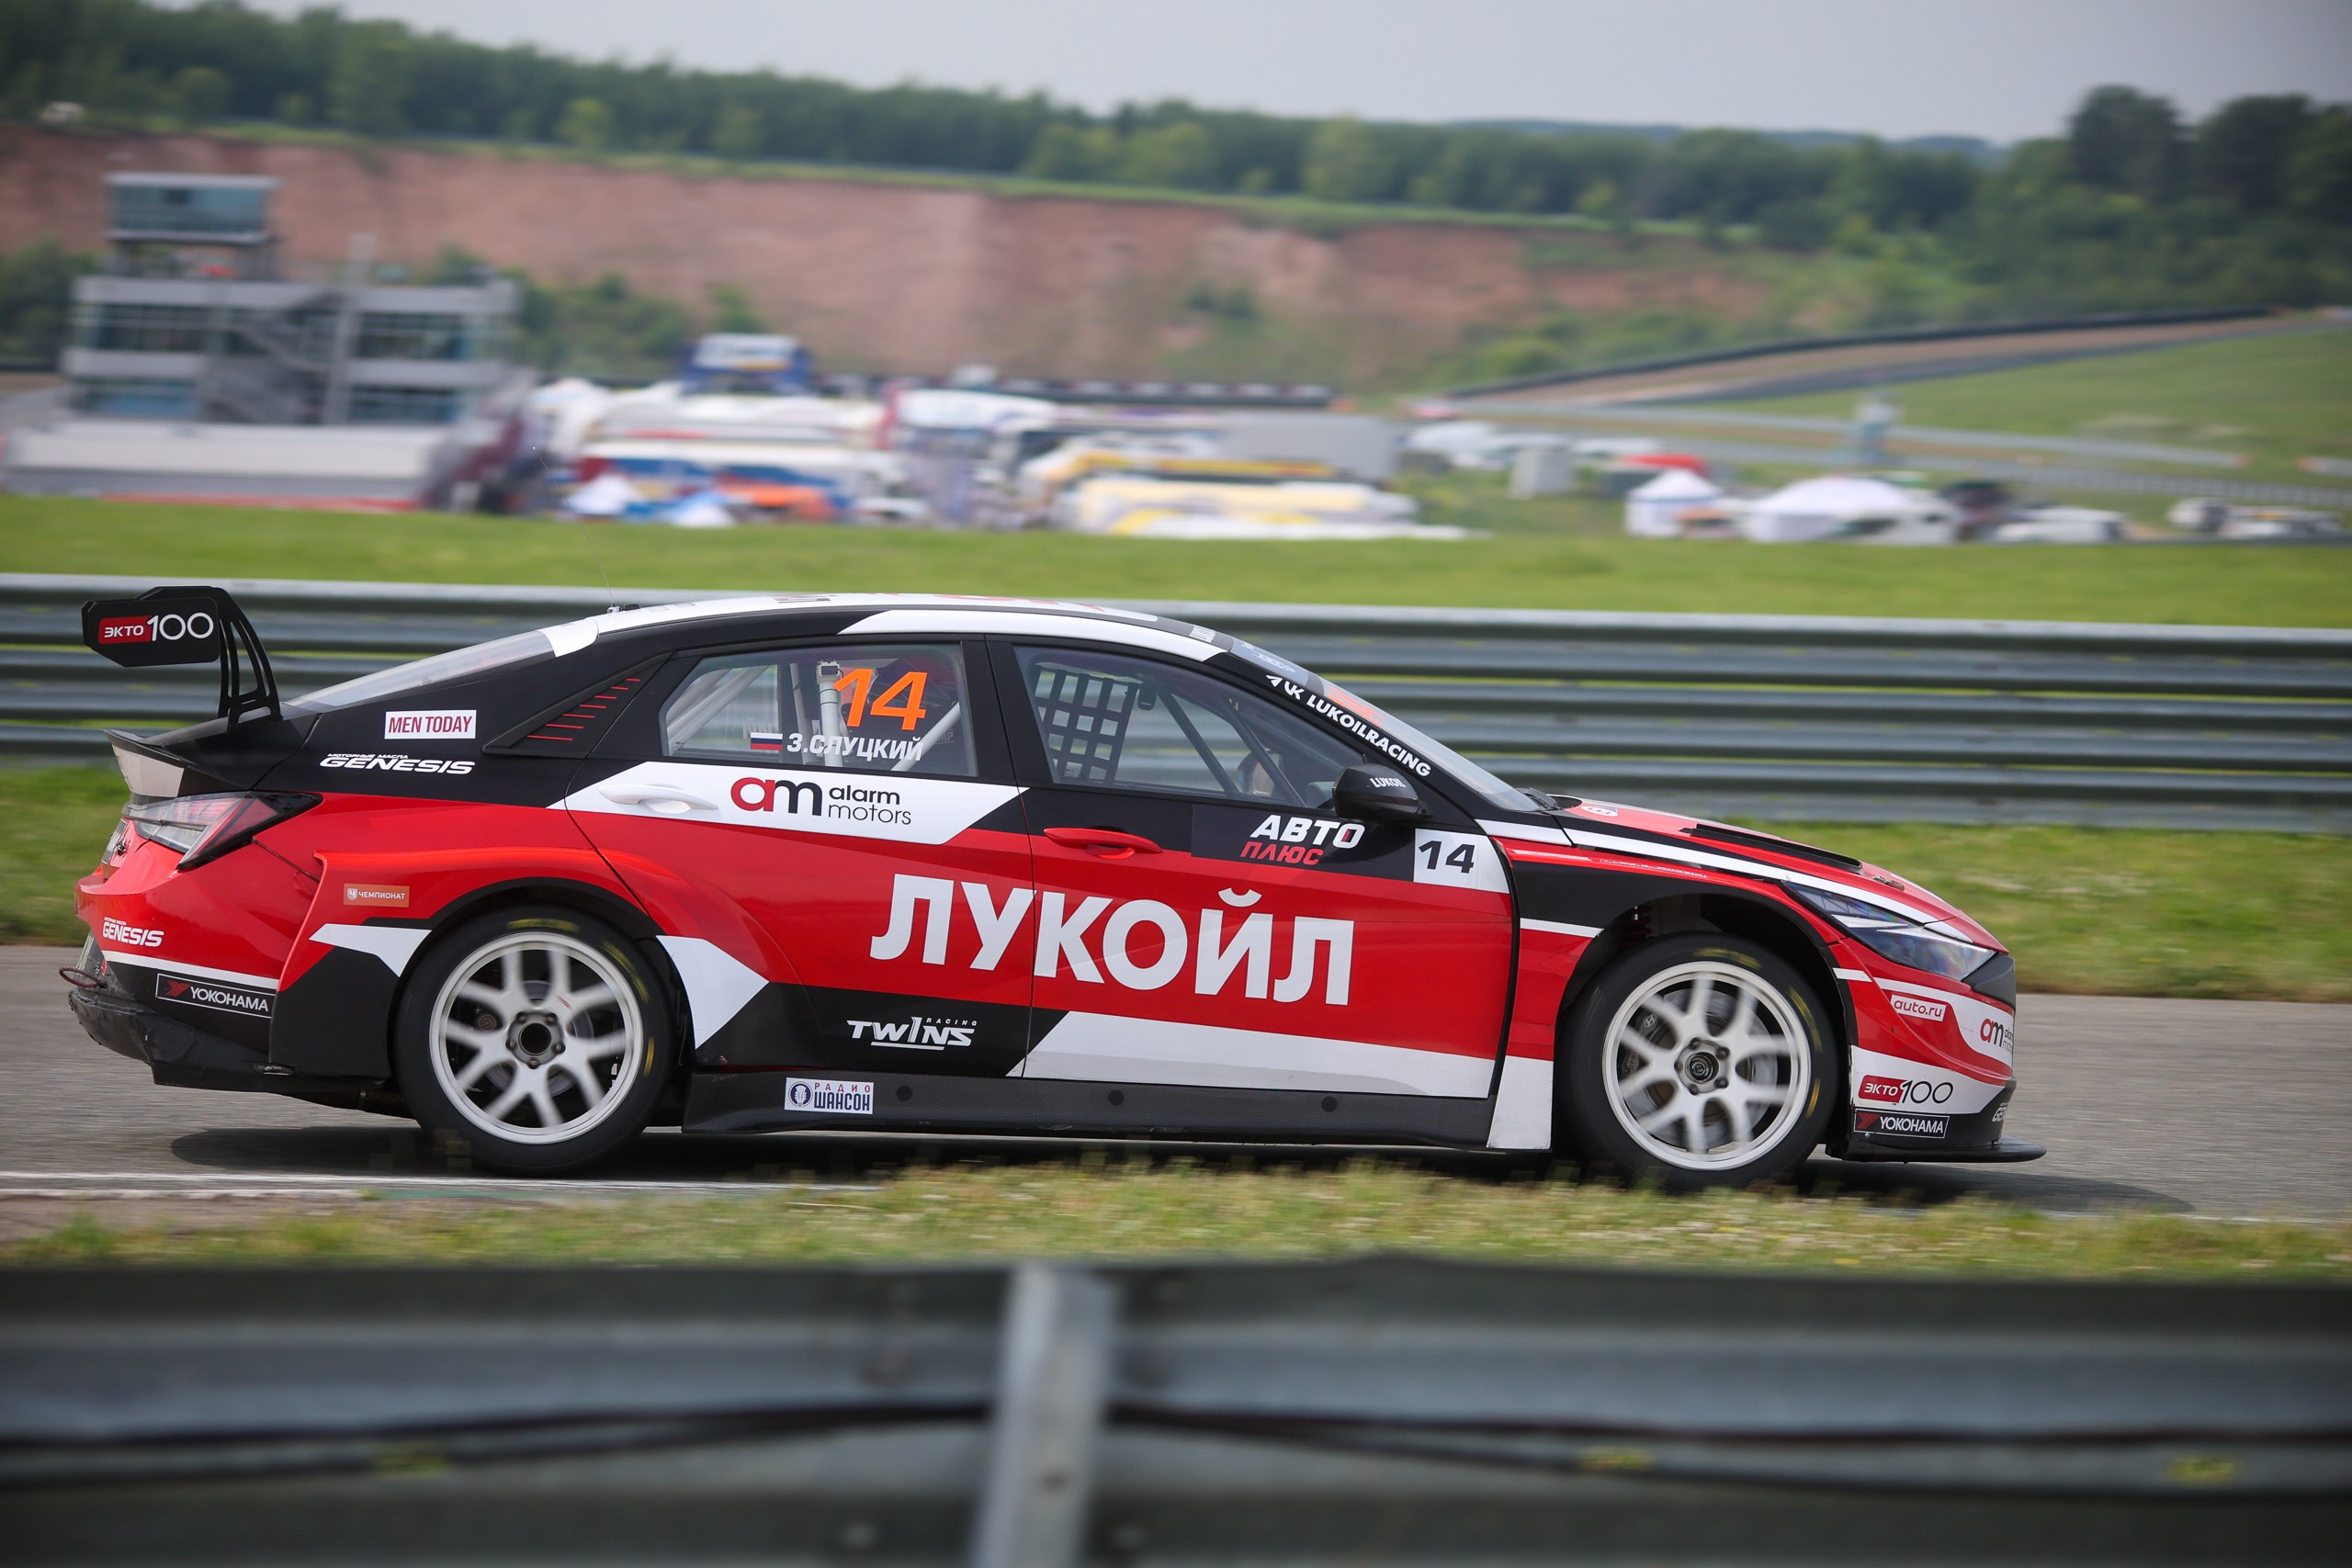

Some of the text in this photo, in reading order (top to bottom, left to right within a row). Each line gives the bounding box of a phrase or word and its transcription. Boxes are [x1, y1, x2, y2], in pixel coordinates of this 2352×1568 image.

[104, 613, 214, 642] ЭКТО 100
[833, 668, 928, 731] 14
[389, 716, 472, 733] MEN TODAY
[1306, 694, 1431, 777] LUKOILRACING
[786, 732, 923, 761] З.СЛУЦКИЙ
[320, 757, 476, 774] GENESIS
[1370, 777, 1407, 788] LUKOIL
[730, 777, 822, 817] am
[829, 785, 900, 806] alarm
[828, 804, 911, 826] motors
[1250, 814, 1366, 849] АВТО
[1240, 840, 1324, 866] ПЛЮС
[1419, 840, 1476, 874] 14
[358, 890, 406, 900] ЧЕМПИОНАТ
[103, 921, 164, 947] GENESIS
[870, 874, 1354, 1006] ЛУКОЙЛ
[190, 985, 269, 1012] YOKOHAMA
[1894, 998, 1943, 1018] auto.ru
[846, 1016, 975, 1047] TWINS
[926, 1017, 978, 1026] RACING
[814, 1082, 871, 1093] РАДИО
[1864, 1079, 1953, 1104] ЭКТО 100
[814, 1091, 870, 1111] ШАНСОН
[1880, 1116, 1943, 1134] YOKOHAMA
